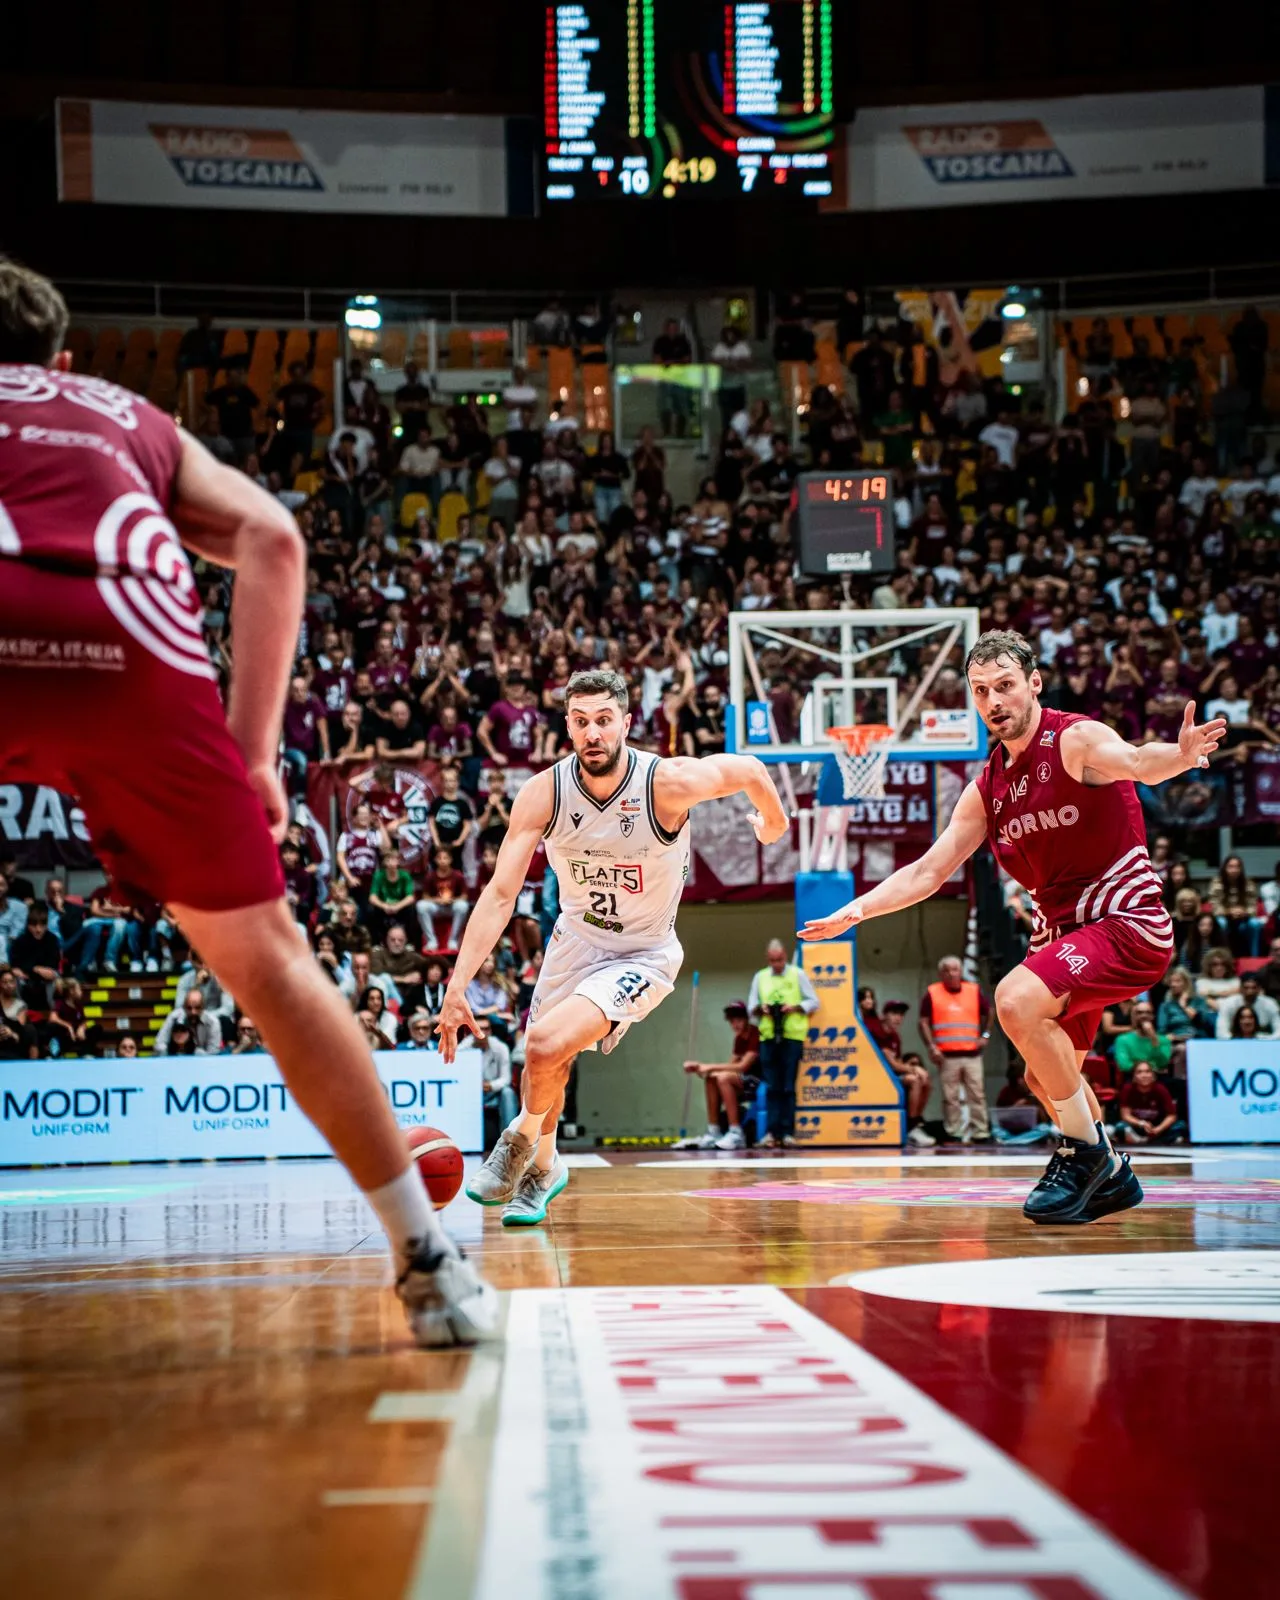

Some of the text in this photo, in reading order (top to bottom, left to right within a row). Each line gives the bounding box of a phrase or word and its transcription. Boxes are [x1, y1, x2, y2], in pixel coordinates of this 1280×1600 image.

[166, 129, 250, 155] RADIO
[920, 125, 1000, 150] RADIO
[180, 160, 315, 187] TOSCANA
[663, 156, 717, 183] 4:19
[739, 167, 759, 192] 7
[935, 153, 1065, 181] TOSCANA
[618, 168, 650, 195] 10
[825, 477, 887, 501] 4:19
[571, 863, 638, 890] FLATS
[589, 879, 618, 889] SERVICE
[589, 891, 618, 916] 21
[1056, 943, 1089, 975] 14
[616, 971, 650, 1004] 21
[381, 1080, 453, 1108] DIT
[1211, 1069, 1280, 1099] MO
[3, 1087, 139, 1121] MODIT
[166, 1084, 287, 1115] MODIT
[31, 1121, 110, 1137] UNIFORM
[193, 1117, 270, 1133] UNIFORM
